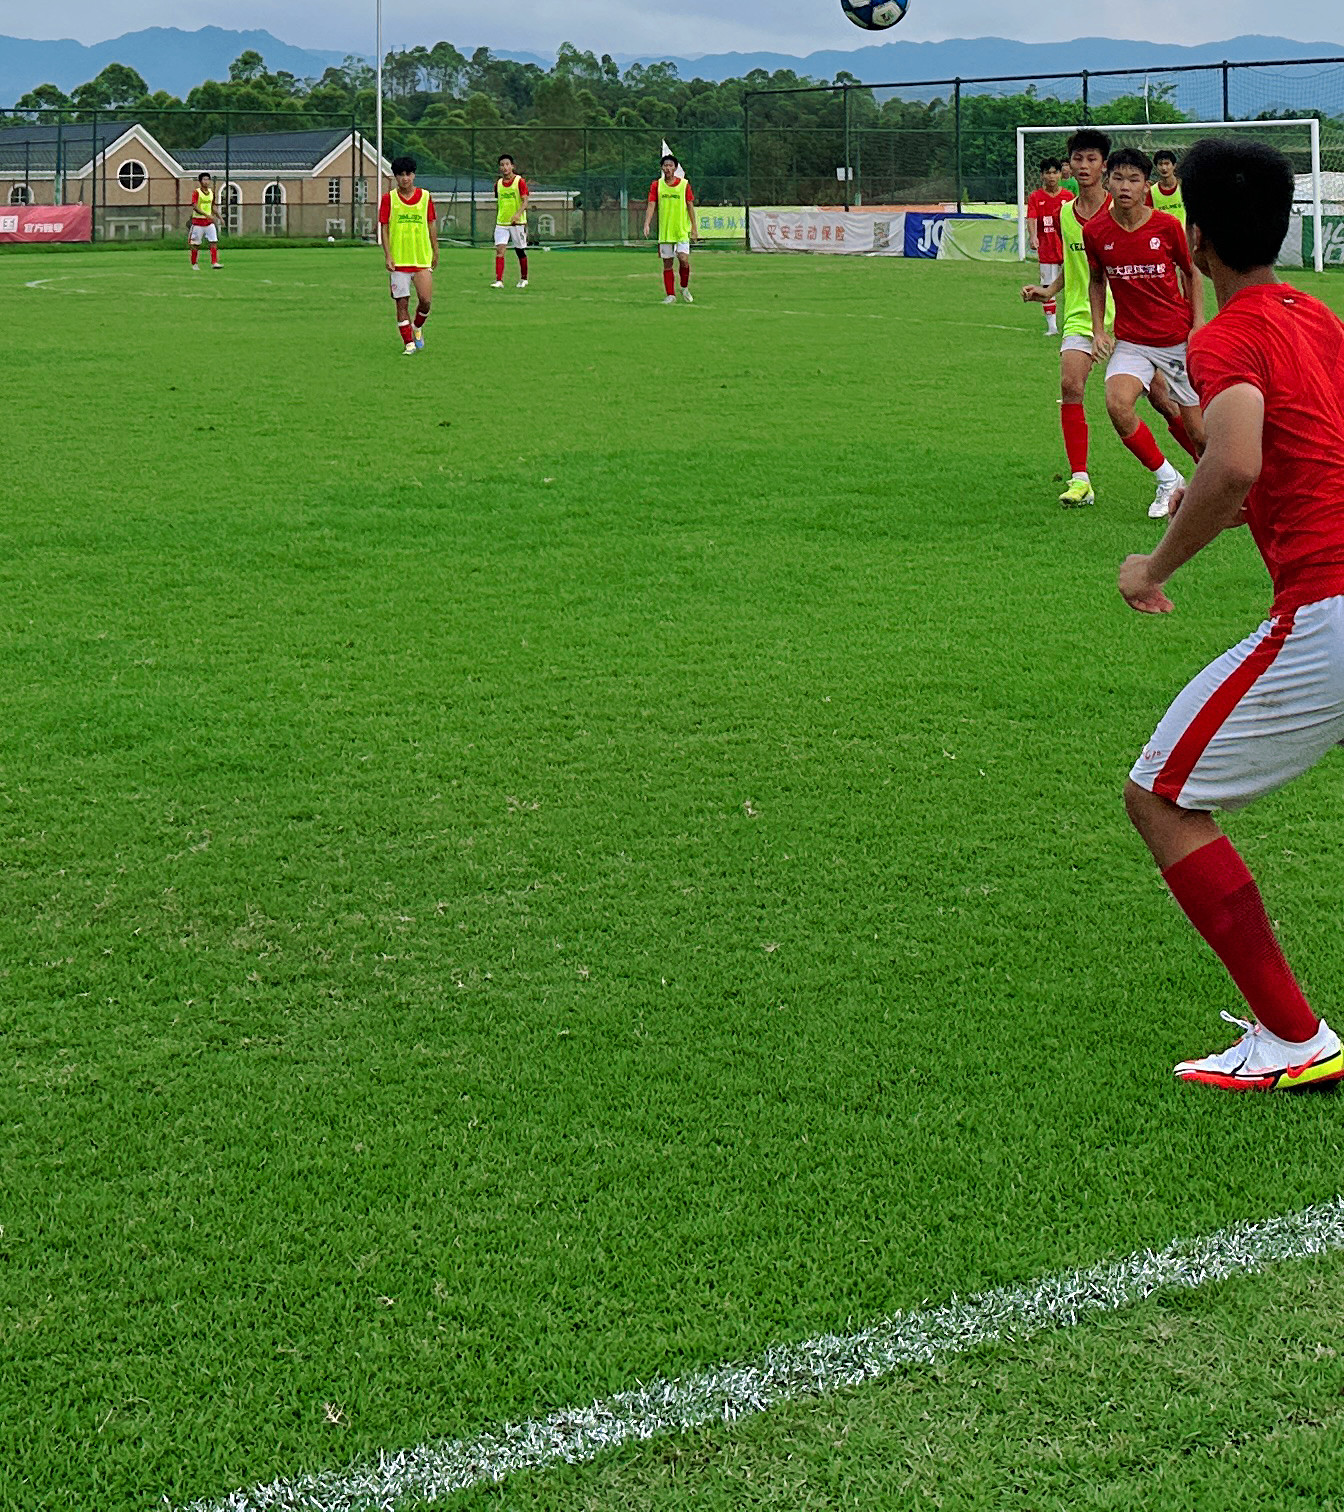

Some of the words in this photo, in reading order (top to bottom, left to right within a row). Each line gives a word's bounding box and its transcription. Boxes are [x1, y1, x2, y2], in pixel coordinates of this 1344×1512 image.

[767, 224, 846, 241] 平安运动保险
